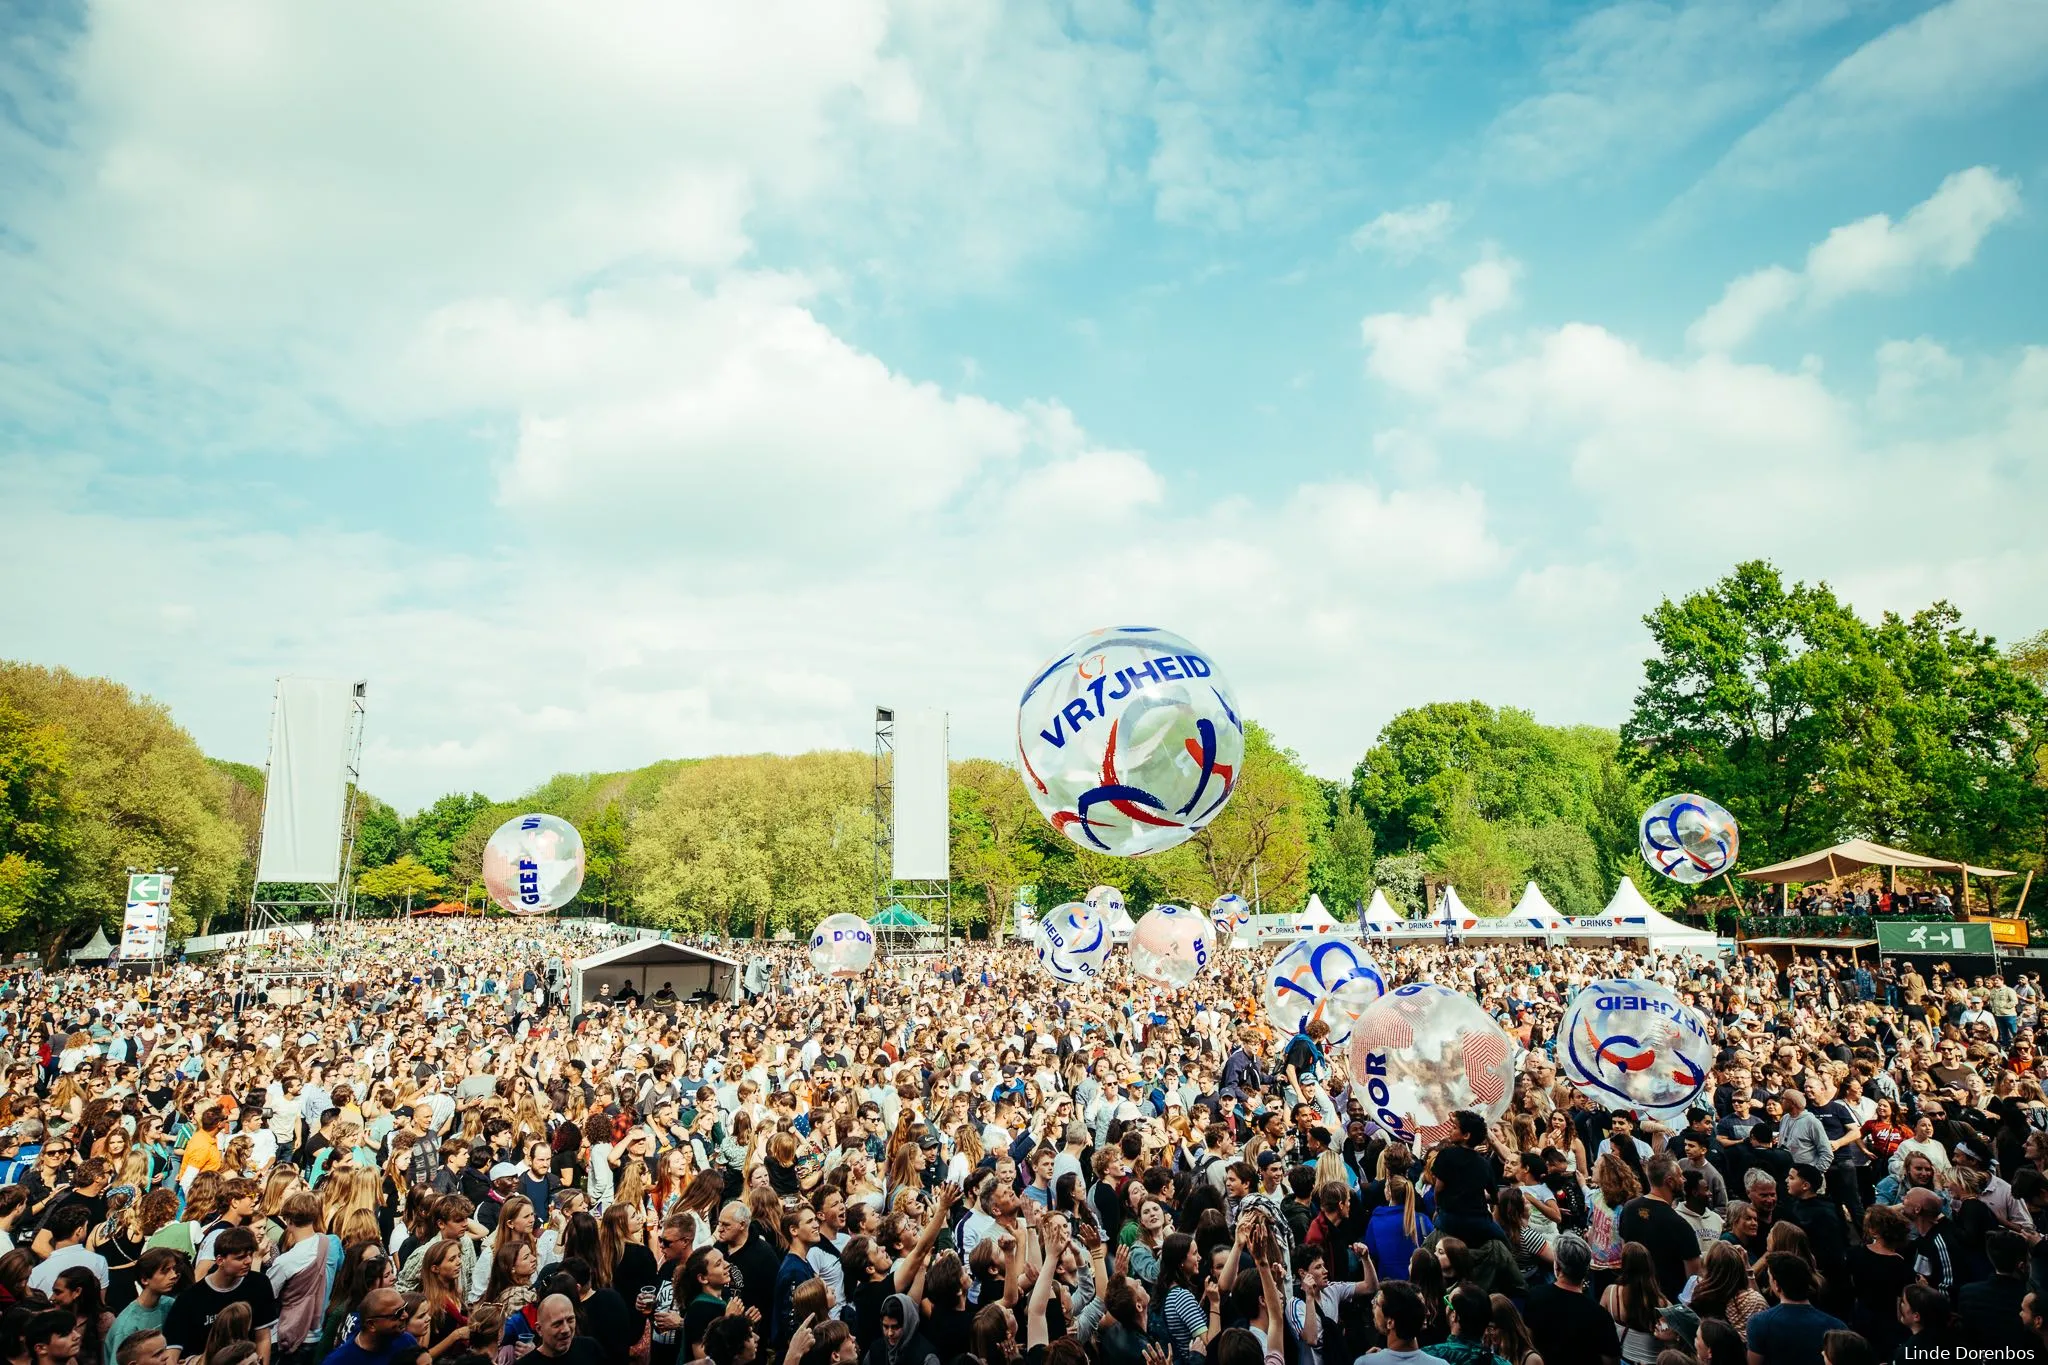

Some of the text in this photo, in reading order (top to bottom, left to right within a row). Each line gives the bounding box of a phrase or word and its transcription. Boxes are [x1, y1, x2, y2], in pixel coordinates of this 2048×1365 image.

[520, 859, 540, 905] GEEF
[833, 930, 872, 944] DOOR
[1580, 919, 1613, 927] DRINKS
[1366, 1052, 1415, 1141] DOOR
